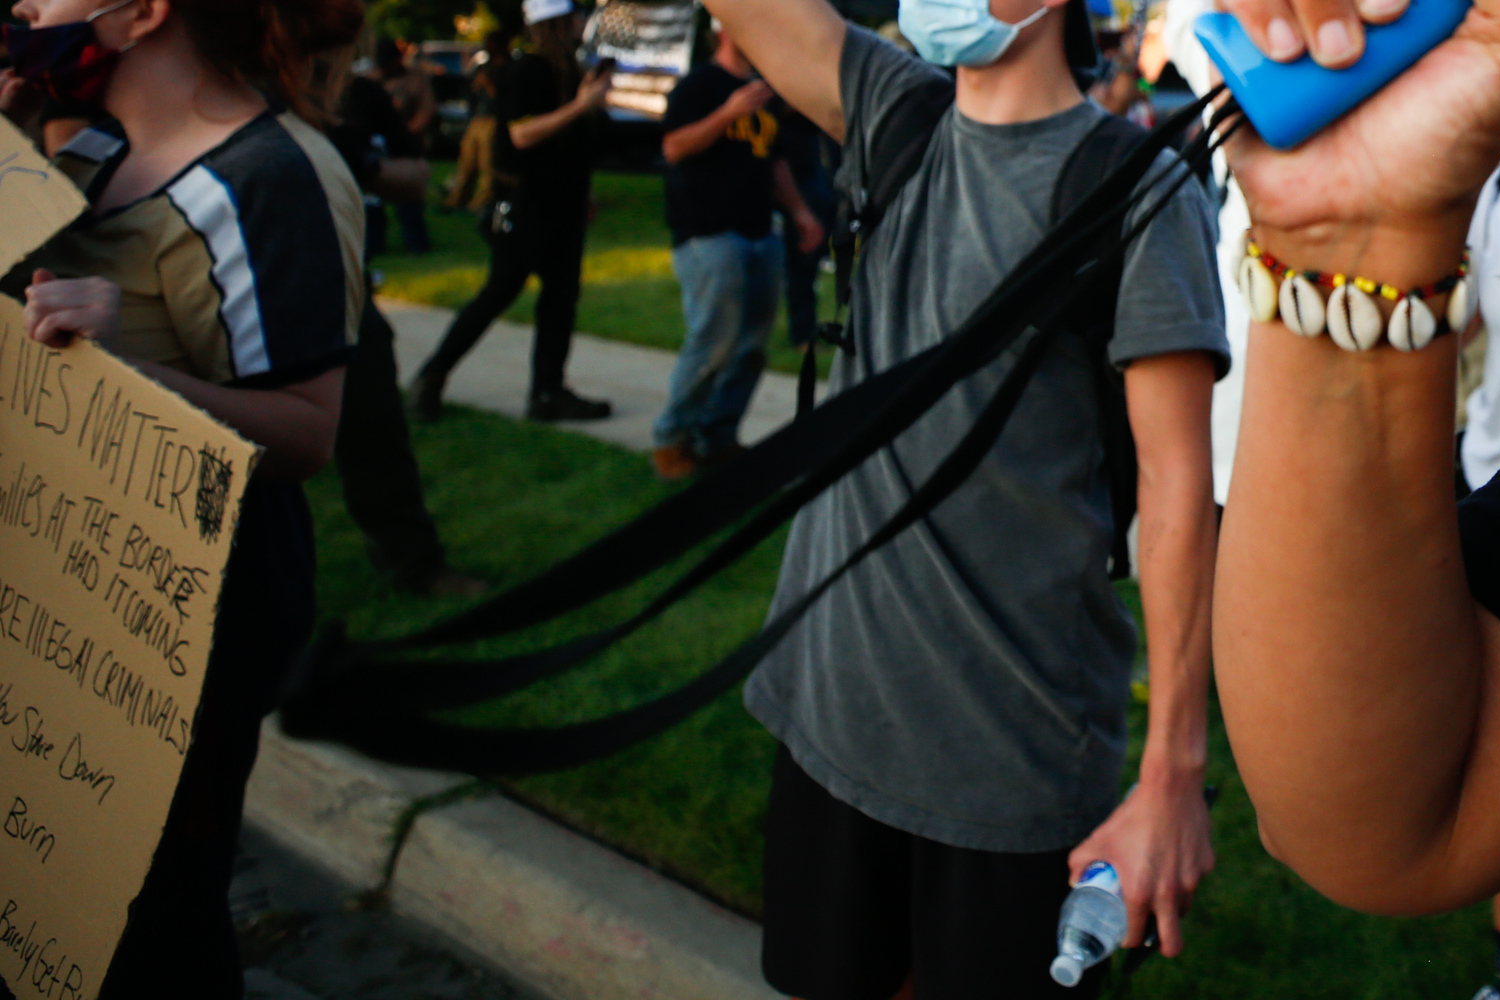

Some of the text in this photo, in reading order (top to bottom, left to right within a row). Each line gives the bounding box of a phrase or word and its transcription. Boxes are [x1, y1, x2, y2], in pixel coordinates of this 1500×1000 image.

[78, 376, 196, 529] MATTER
[44, 492, 76, 554] AT
[81, 495, 120, 555] THE
[62, 540, 100, 592] HAD
[123, 590, 190, 677] COMING
[93, 650, 189, 756] CRIMINALS
[4, 796, 56, 864] Burn
